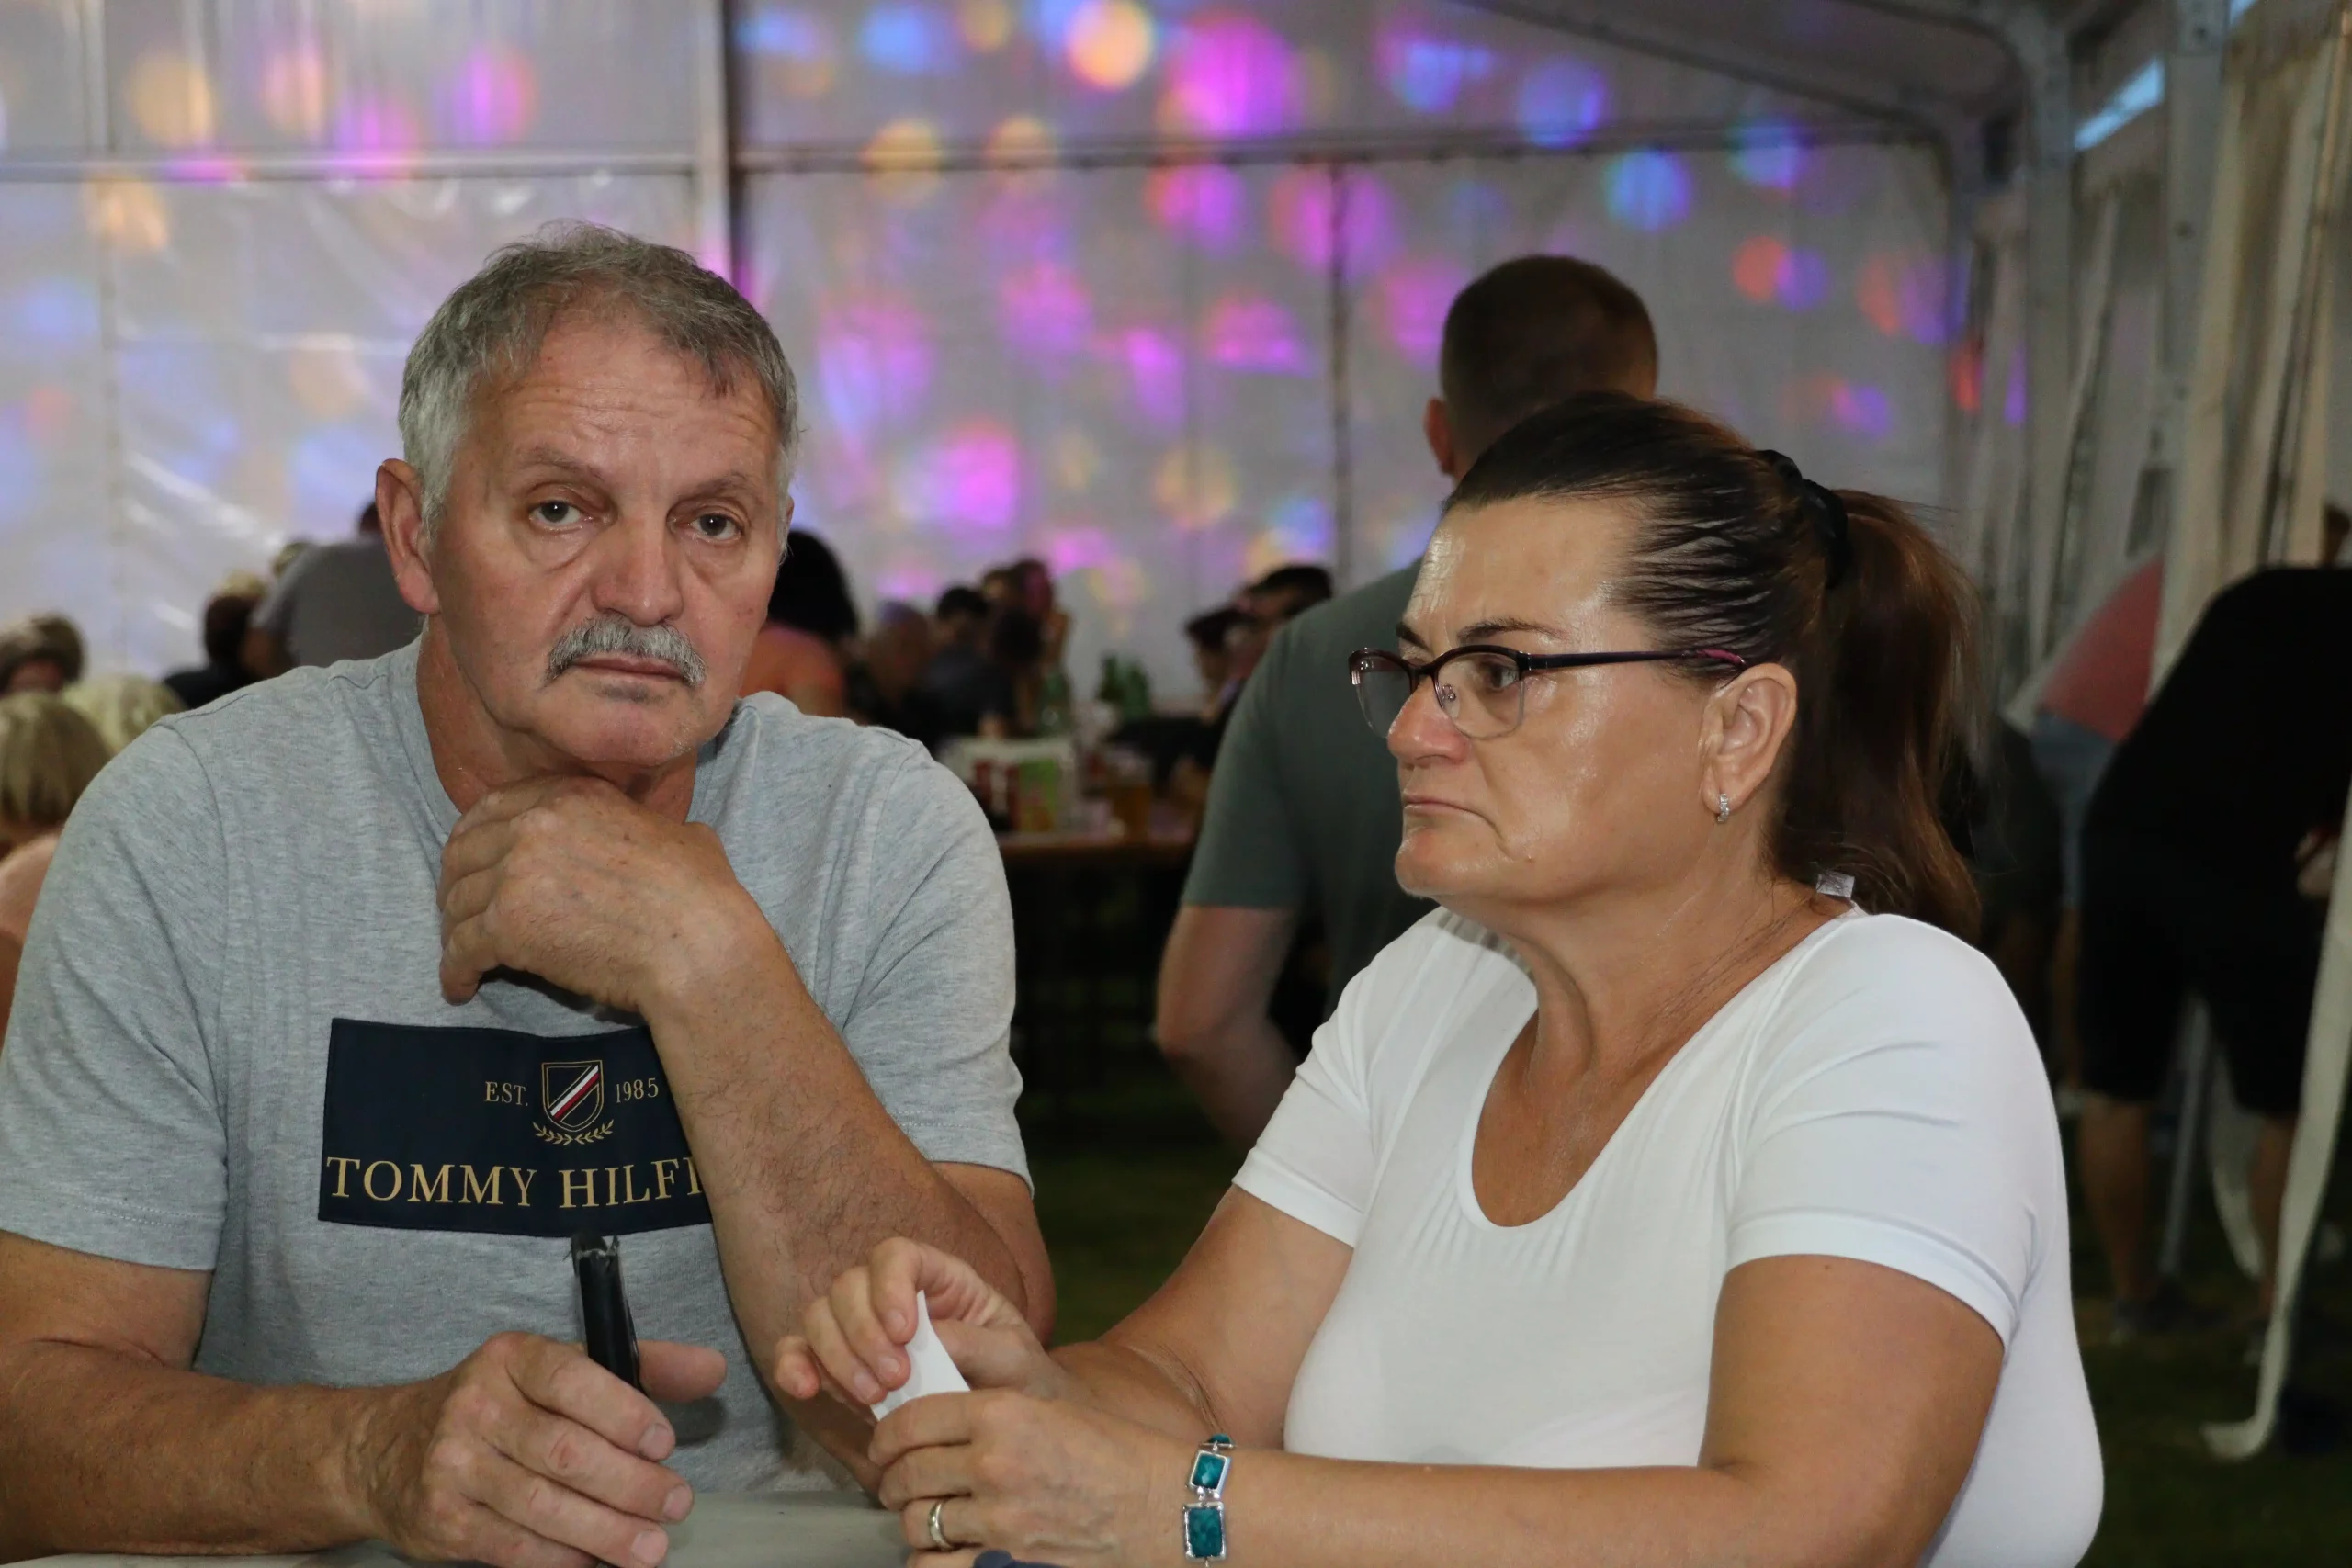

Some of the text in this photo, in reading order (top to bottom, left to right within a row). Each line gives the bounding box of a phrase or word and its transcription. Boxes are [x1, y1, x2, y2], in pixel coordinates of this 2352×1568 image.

[484, 1077, 659, 1106] EST. 1985
[326, 1156, 537, 1207] TOMMY
